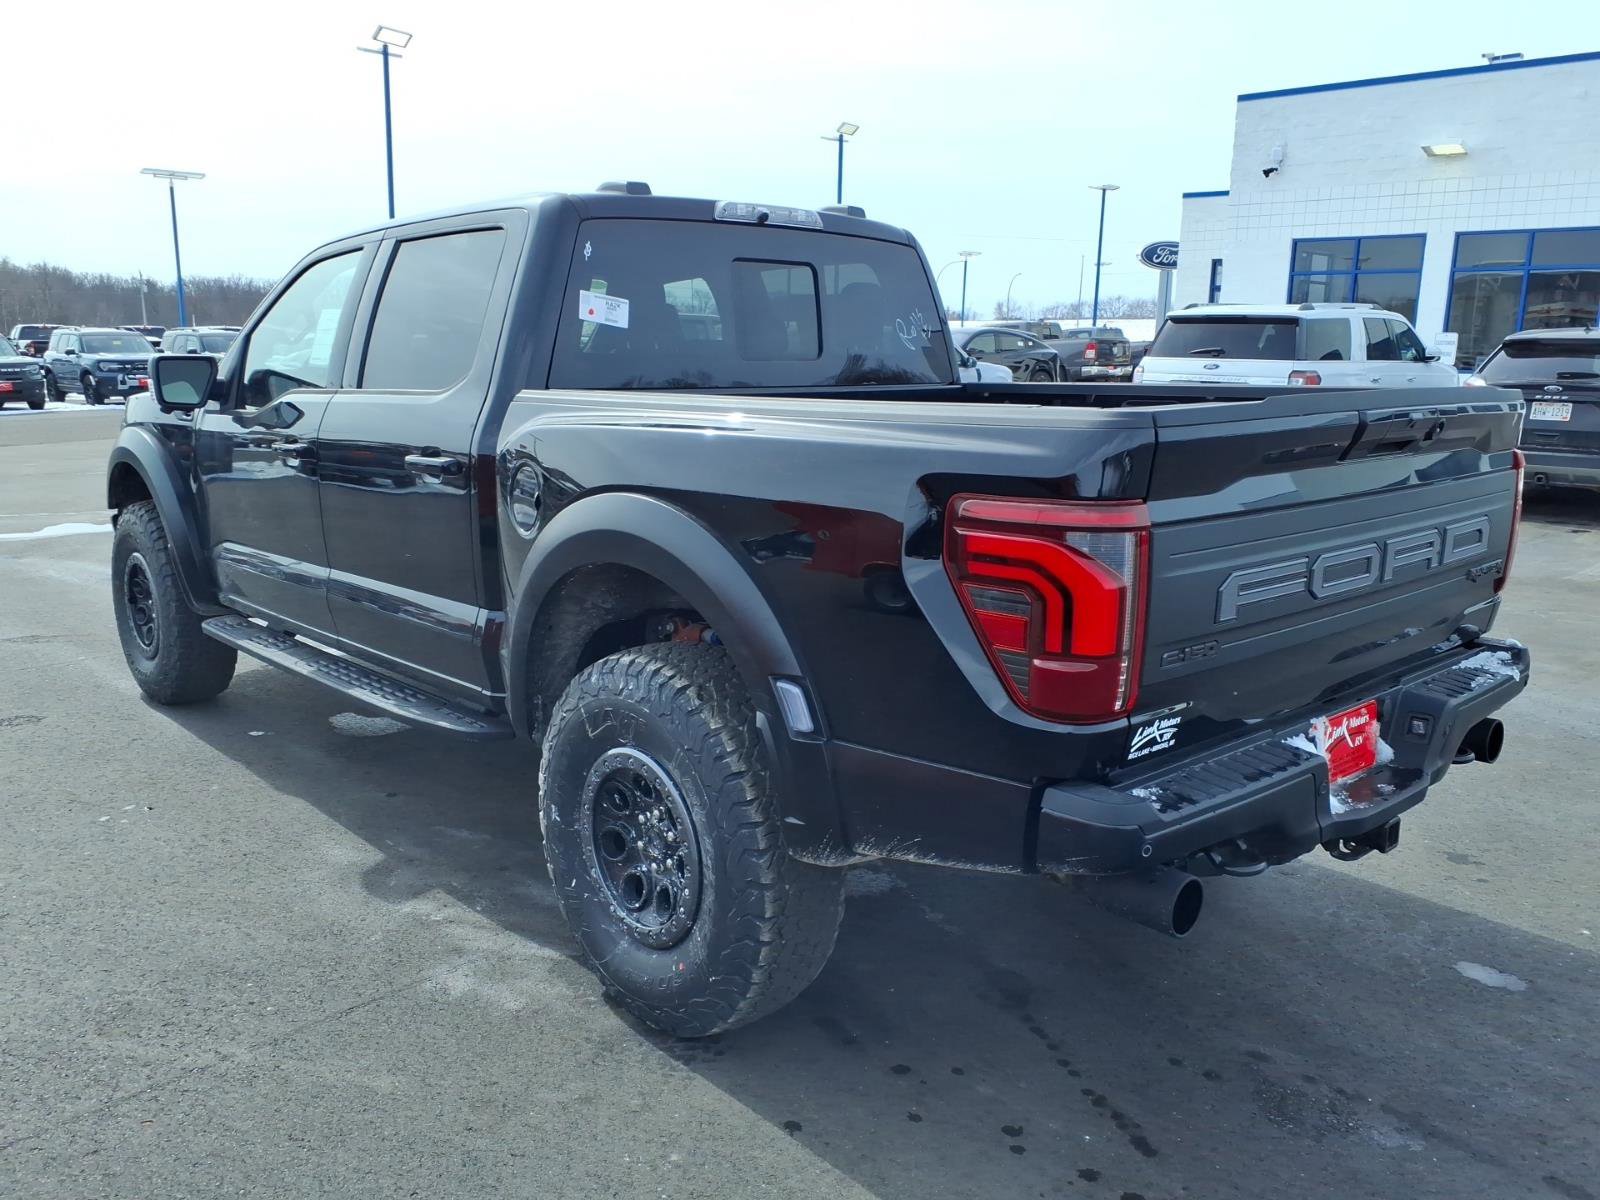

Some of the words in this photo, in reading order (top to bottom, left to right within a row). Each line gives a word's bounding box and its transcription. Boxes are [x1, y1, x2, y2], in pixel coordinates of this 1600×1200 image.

[1153, 246, 1178, 263] For
[1215, 515, 1490, 623] FORD
[1131, 719, 1161, 746] Link
[1158, 716, 1182, 730] Motors
[1349, 714, 1370, 729] Motors
